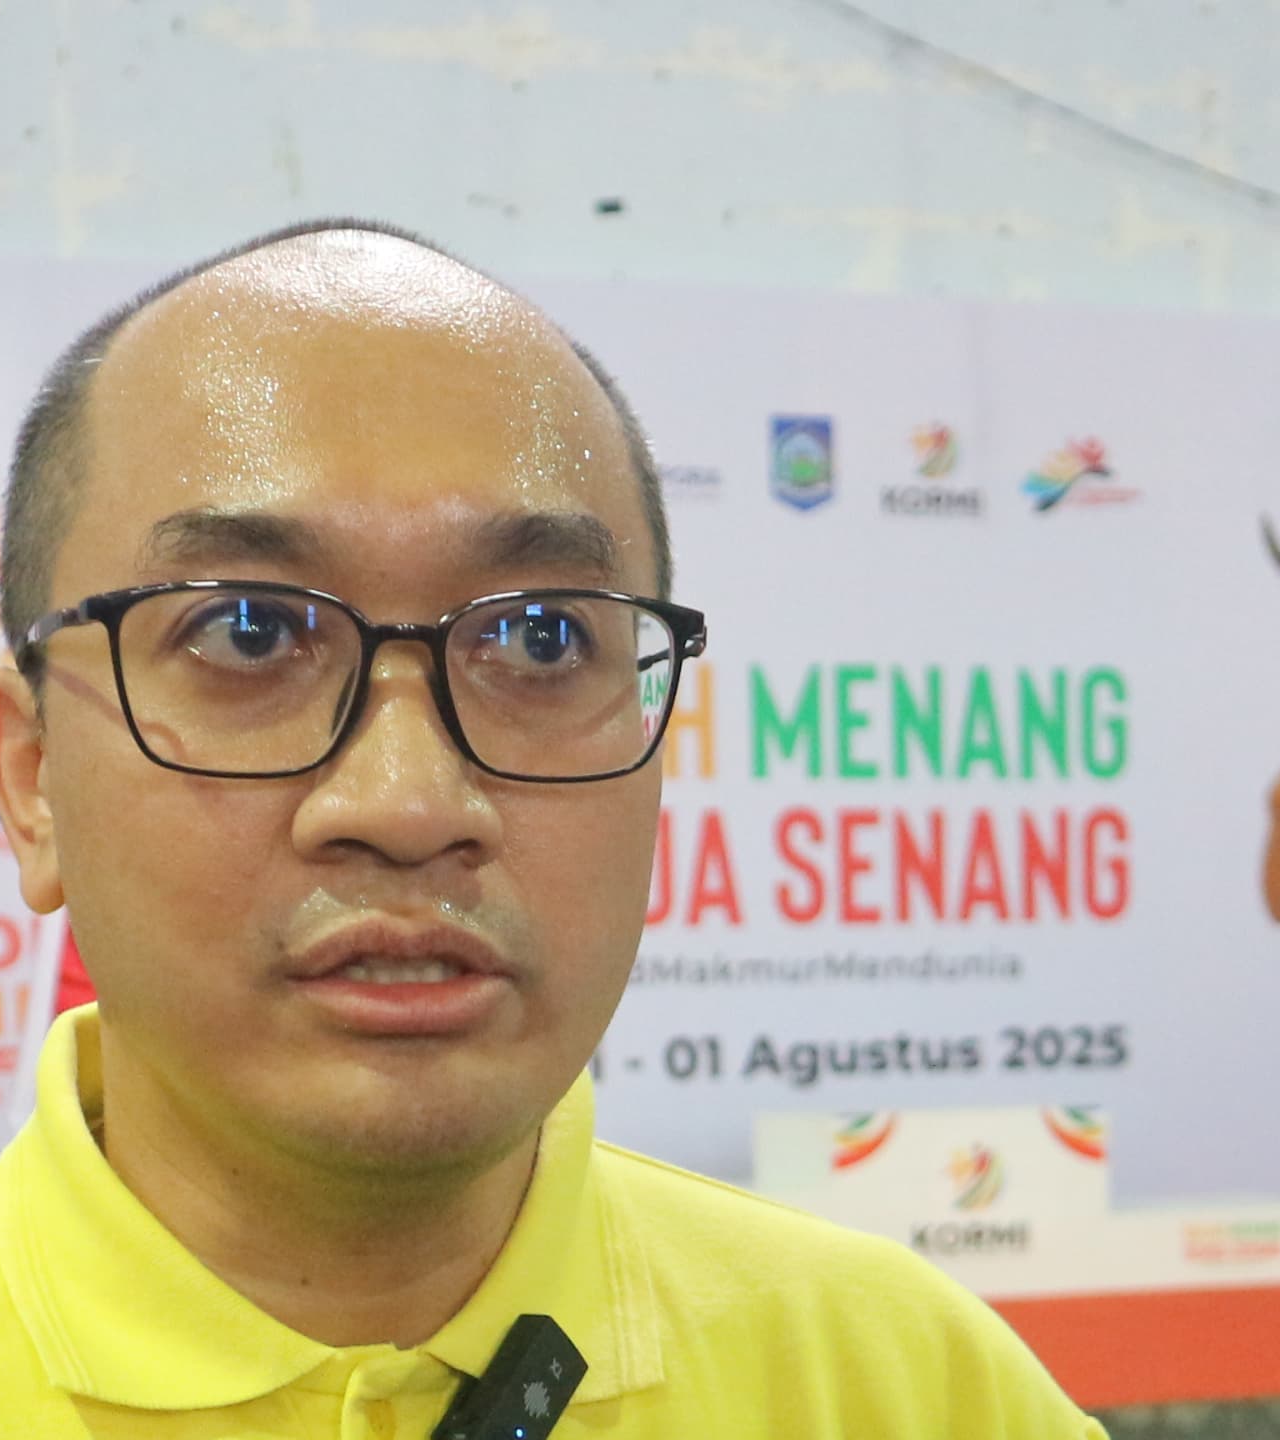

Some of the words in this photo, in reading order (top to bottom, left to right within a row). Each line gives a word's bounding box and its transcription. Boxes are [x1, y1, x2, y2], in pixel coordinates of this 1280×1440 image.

[748, 662, 1128, 781] MENANG
[773, 806, 1131, 925] SENANG
[664, 1036, 720, 1079] 01
[742, 1034, 982, 1086] Agustus
[999, 1026, 1128, 1068] 2025
[912, 1222, 1032, 1256] KORMI
